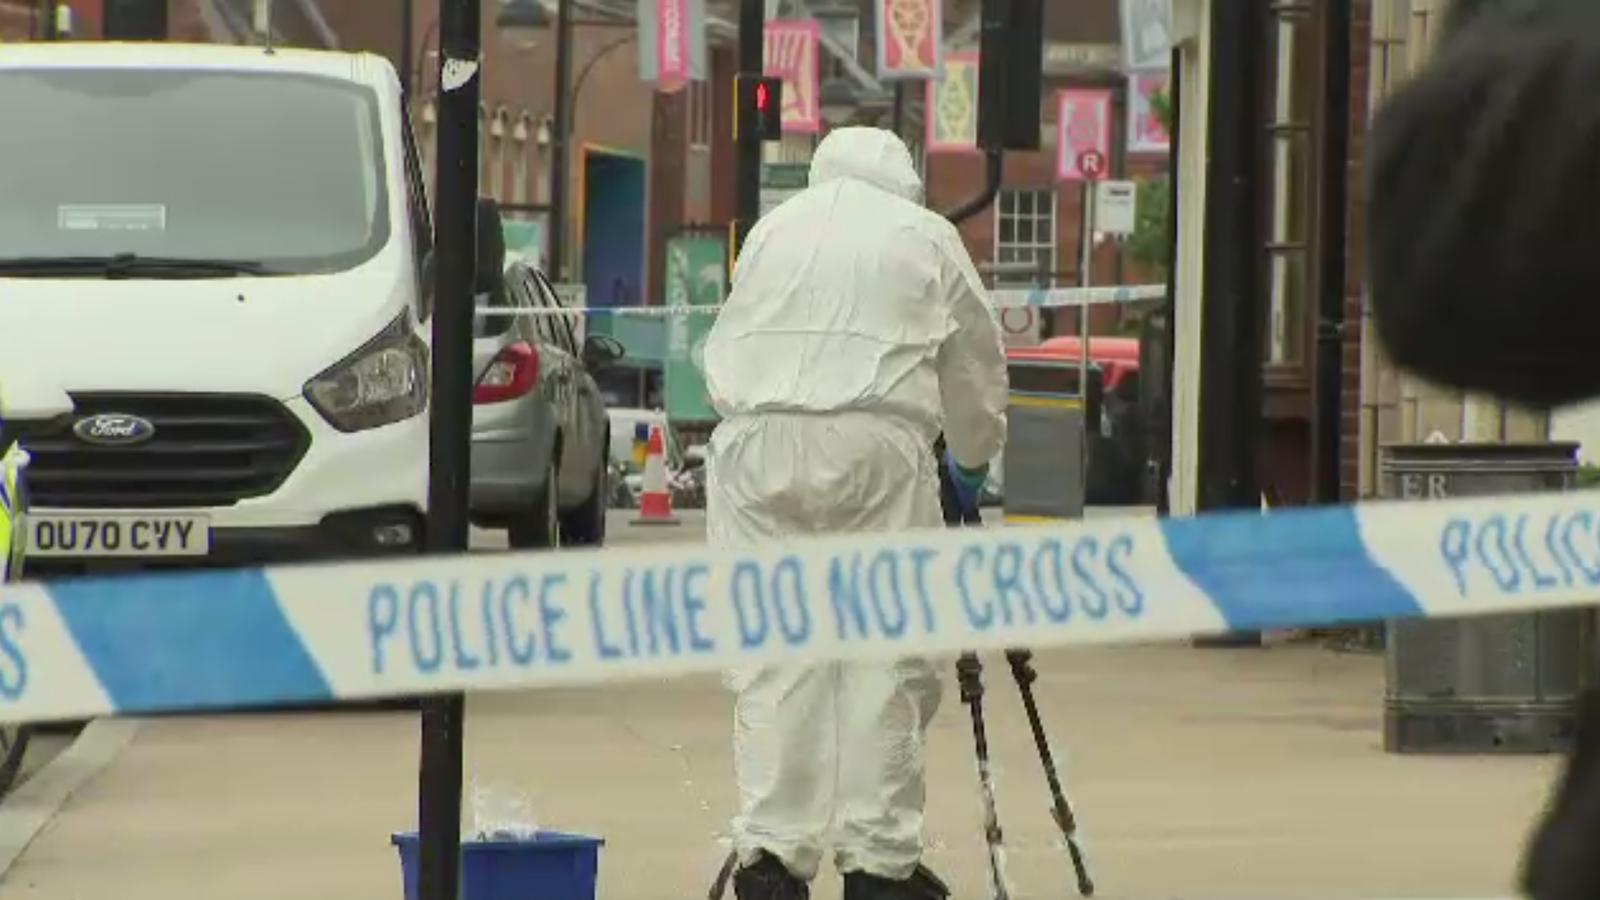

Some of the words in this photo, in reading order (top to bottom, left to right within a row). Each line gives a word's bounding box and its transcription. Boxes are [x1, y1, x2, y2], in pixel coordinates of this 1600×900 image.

[1081, 153, 1099, 174] R
[90, 416, 137, 437] Ford
[36, 520, 121, 551] OU70
[130, 520, 195, 551] CVY
[368, 574, 571, 676] POLICE
[590, 563, 715, 660] LINE
[731, 557, 812, 650] DO
[829, 548, 937, 639] NOT
[955, 535, 1146, 628] CROSS
[1440, 511, 1600, 597] POLIC
